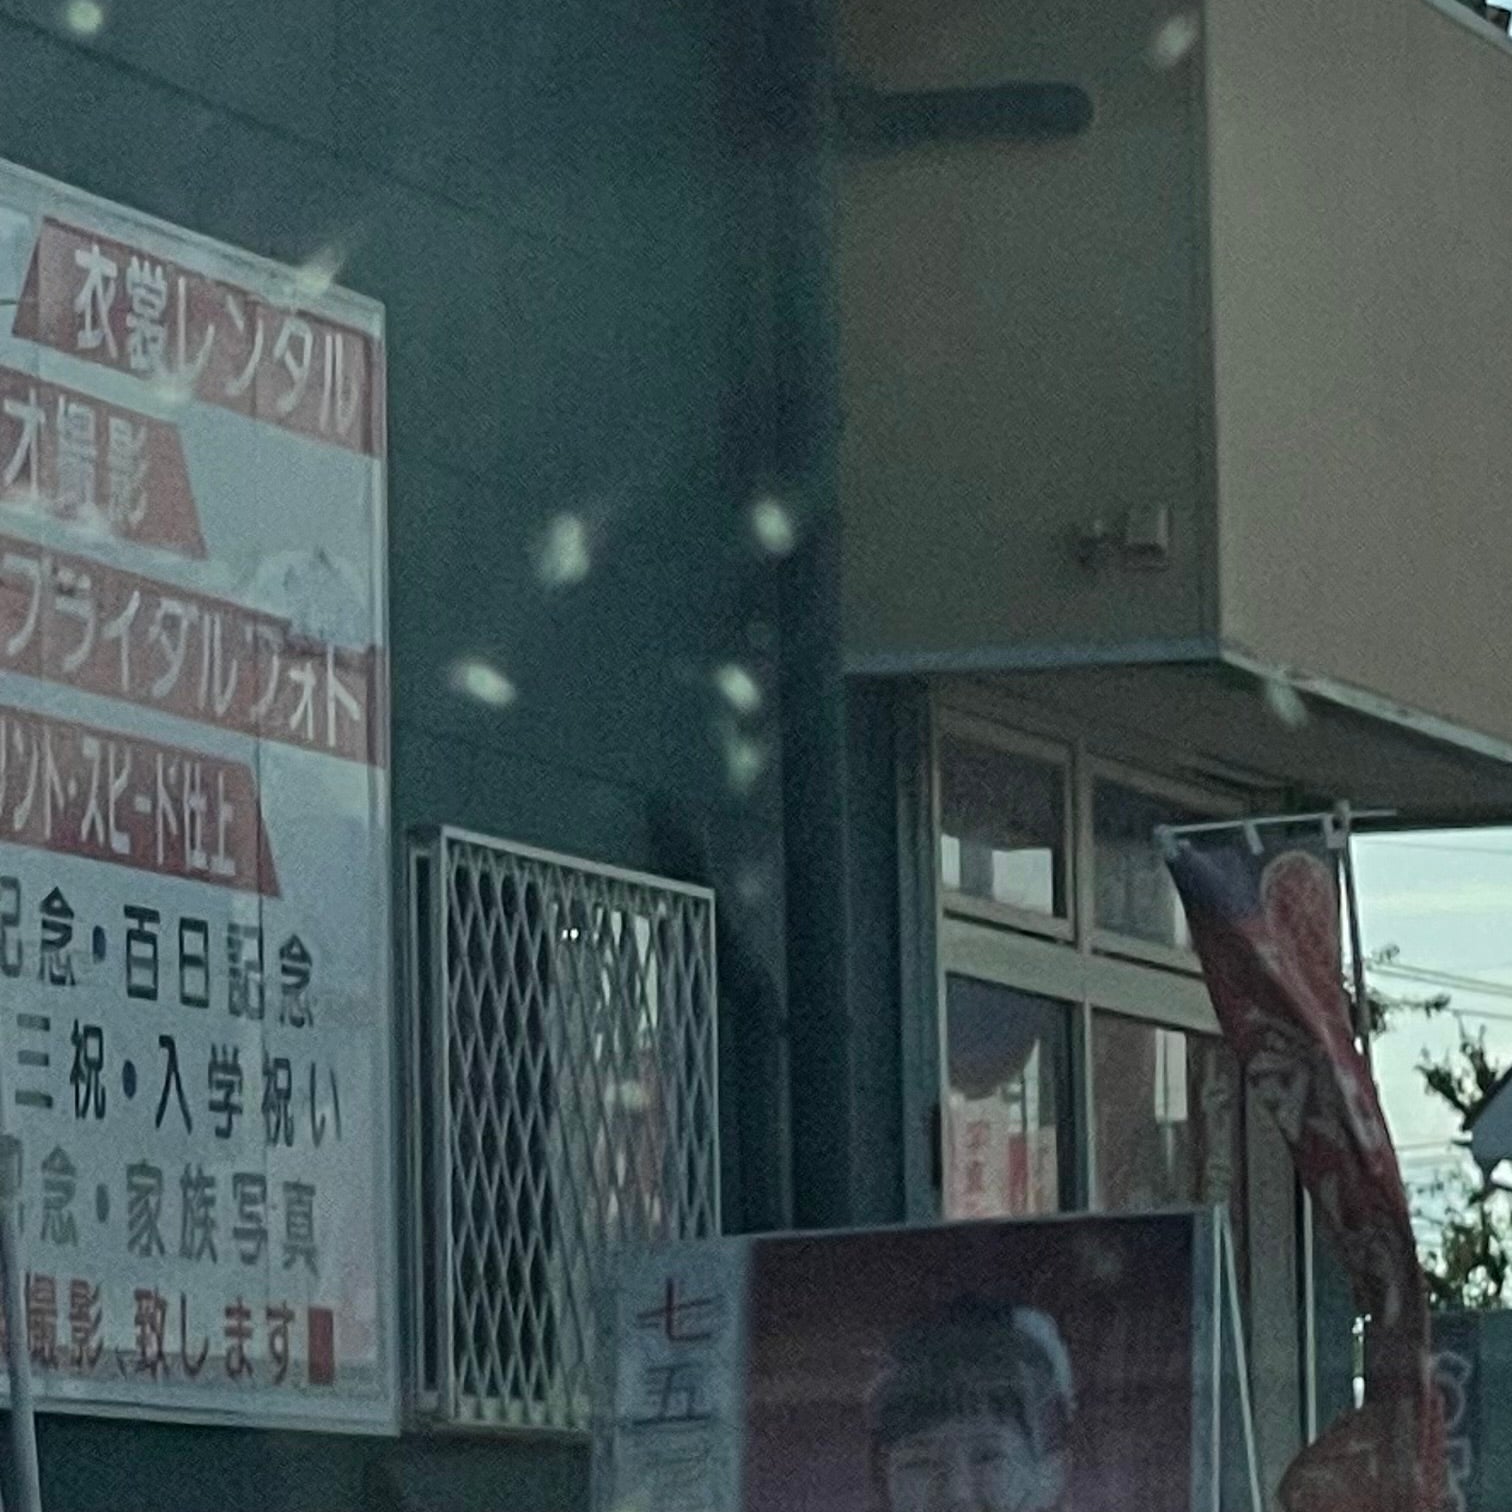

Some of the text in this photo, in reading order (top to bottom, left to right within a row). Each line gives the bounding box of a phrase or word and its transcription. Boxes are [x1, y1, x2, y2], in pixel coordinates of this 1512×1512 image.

[74, 243, 361, 437] 衣裳レンタル
